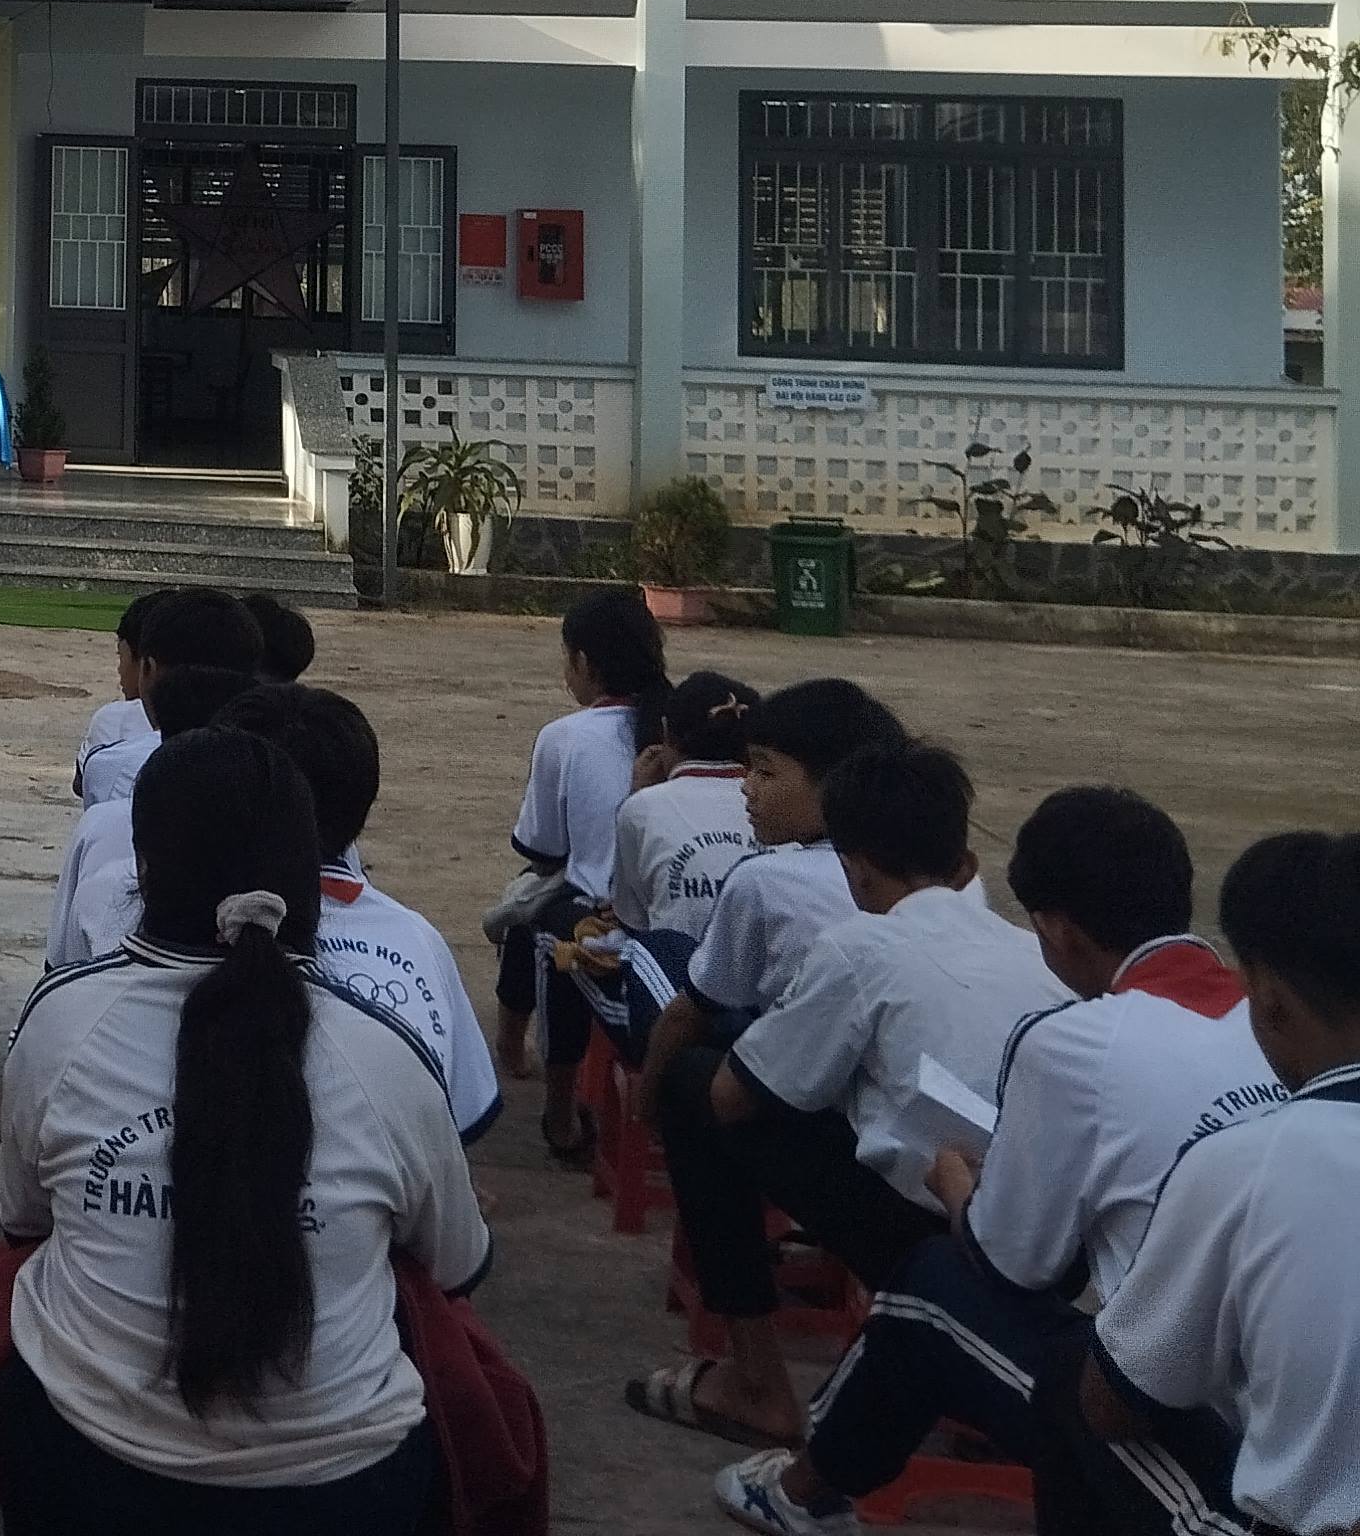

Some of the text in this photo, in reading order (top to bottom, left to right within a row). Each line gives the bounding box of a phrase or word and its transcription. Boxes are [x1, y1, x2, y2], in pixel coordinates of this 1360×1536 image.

[692, 830, 743, 850] TRUNG
[316, 937, 368, 954] RUNG
[376, 945, 415, 974] HỌC
[1212, 1082, 1289, 1117] TRUNG
[83, 1126, 140, 1213] TRƯỜNG
